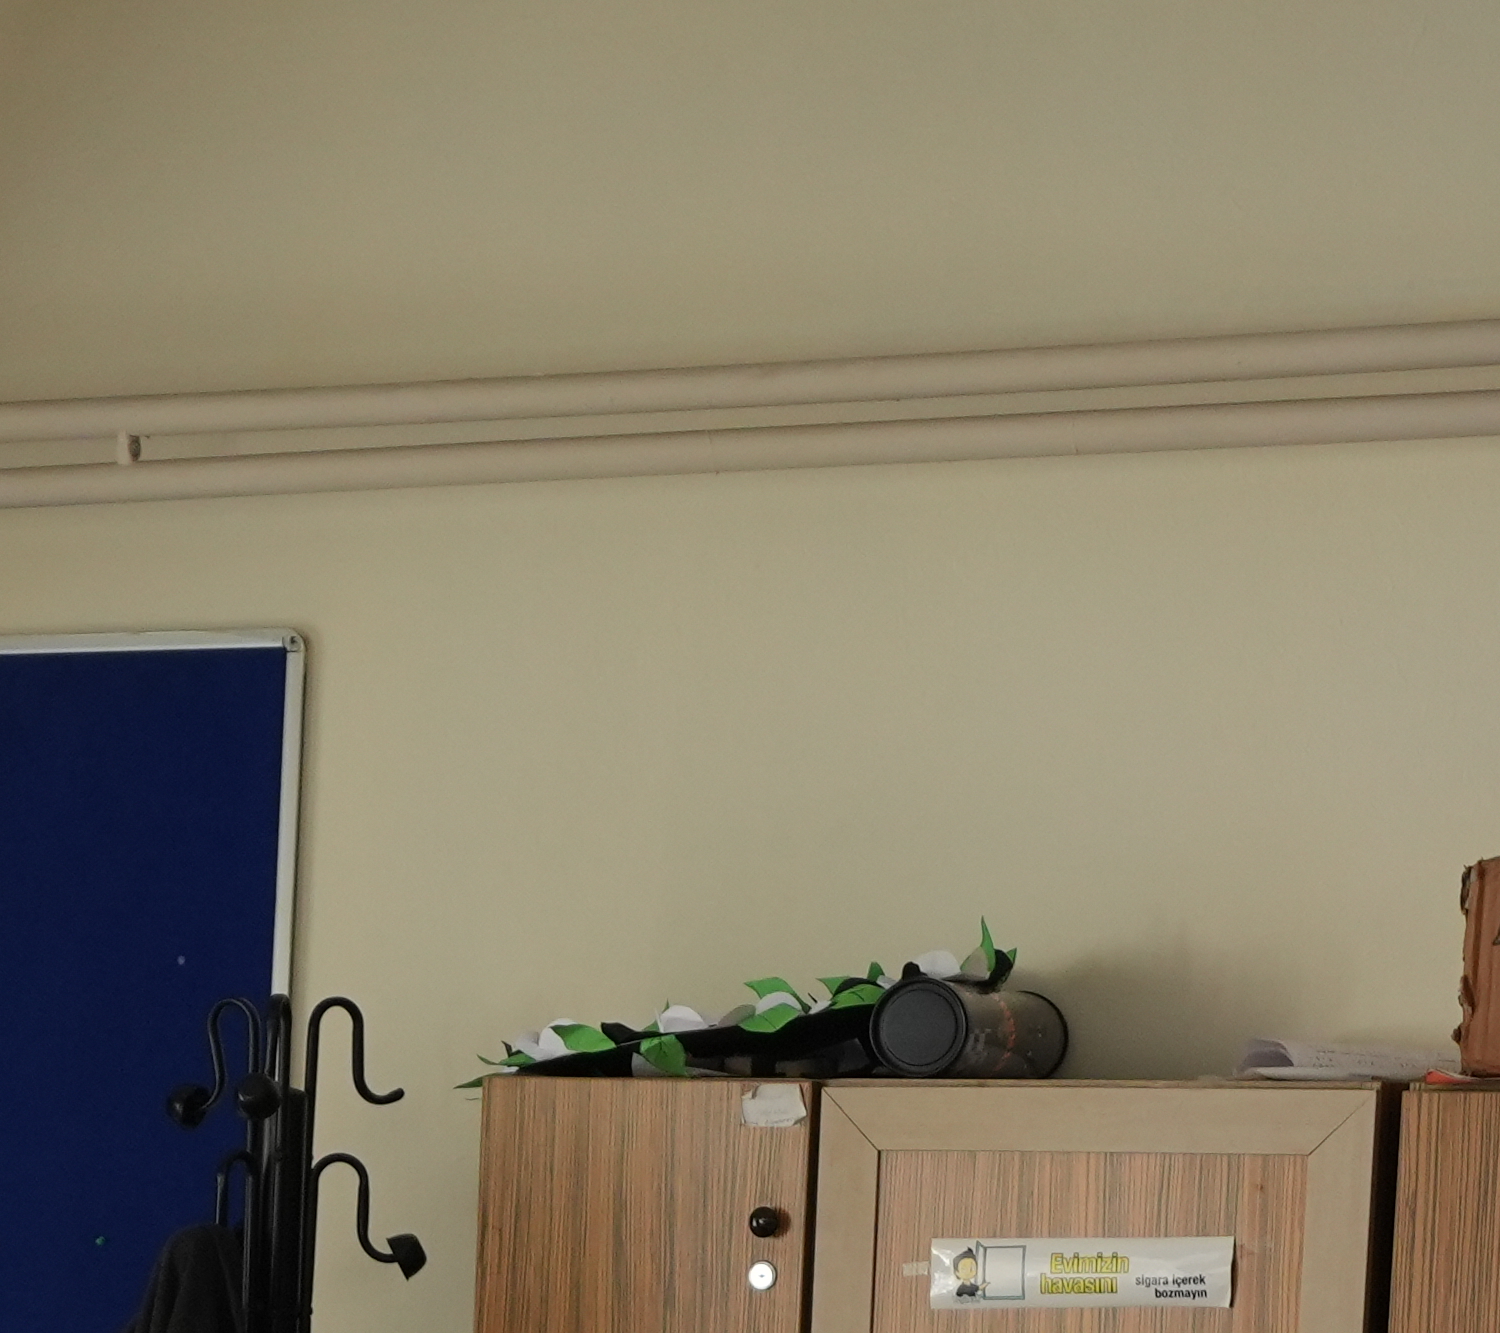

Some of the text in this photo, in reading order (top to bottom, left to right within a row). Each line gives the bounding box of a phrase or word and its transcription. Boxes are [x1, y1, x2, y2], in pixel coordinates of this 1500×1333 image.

[1050, 1252, 1130, 1274] Evimizin
[1040, 1273, 1118, 1295] havasını
[1135, 1273, 1206, 1288] sigara içerek
[1154, 1287, 1207, 1300] bozmayın
